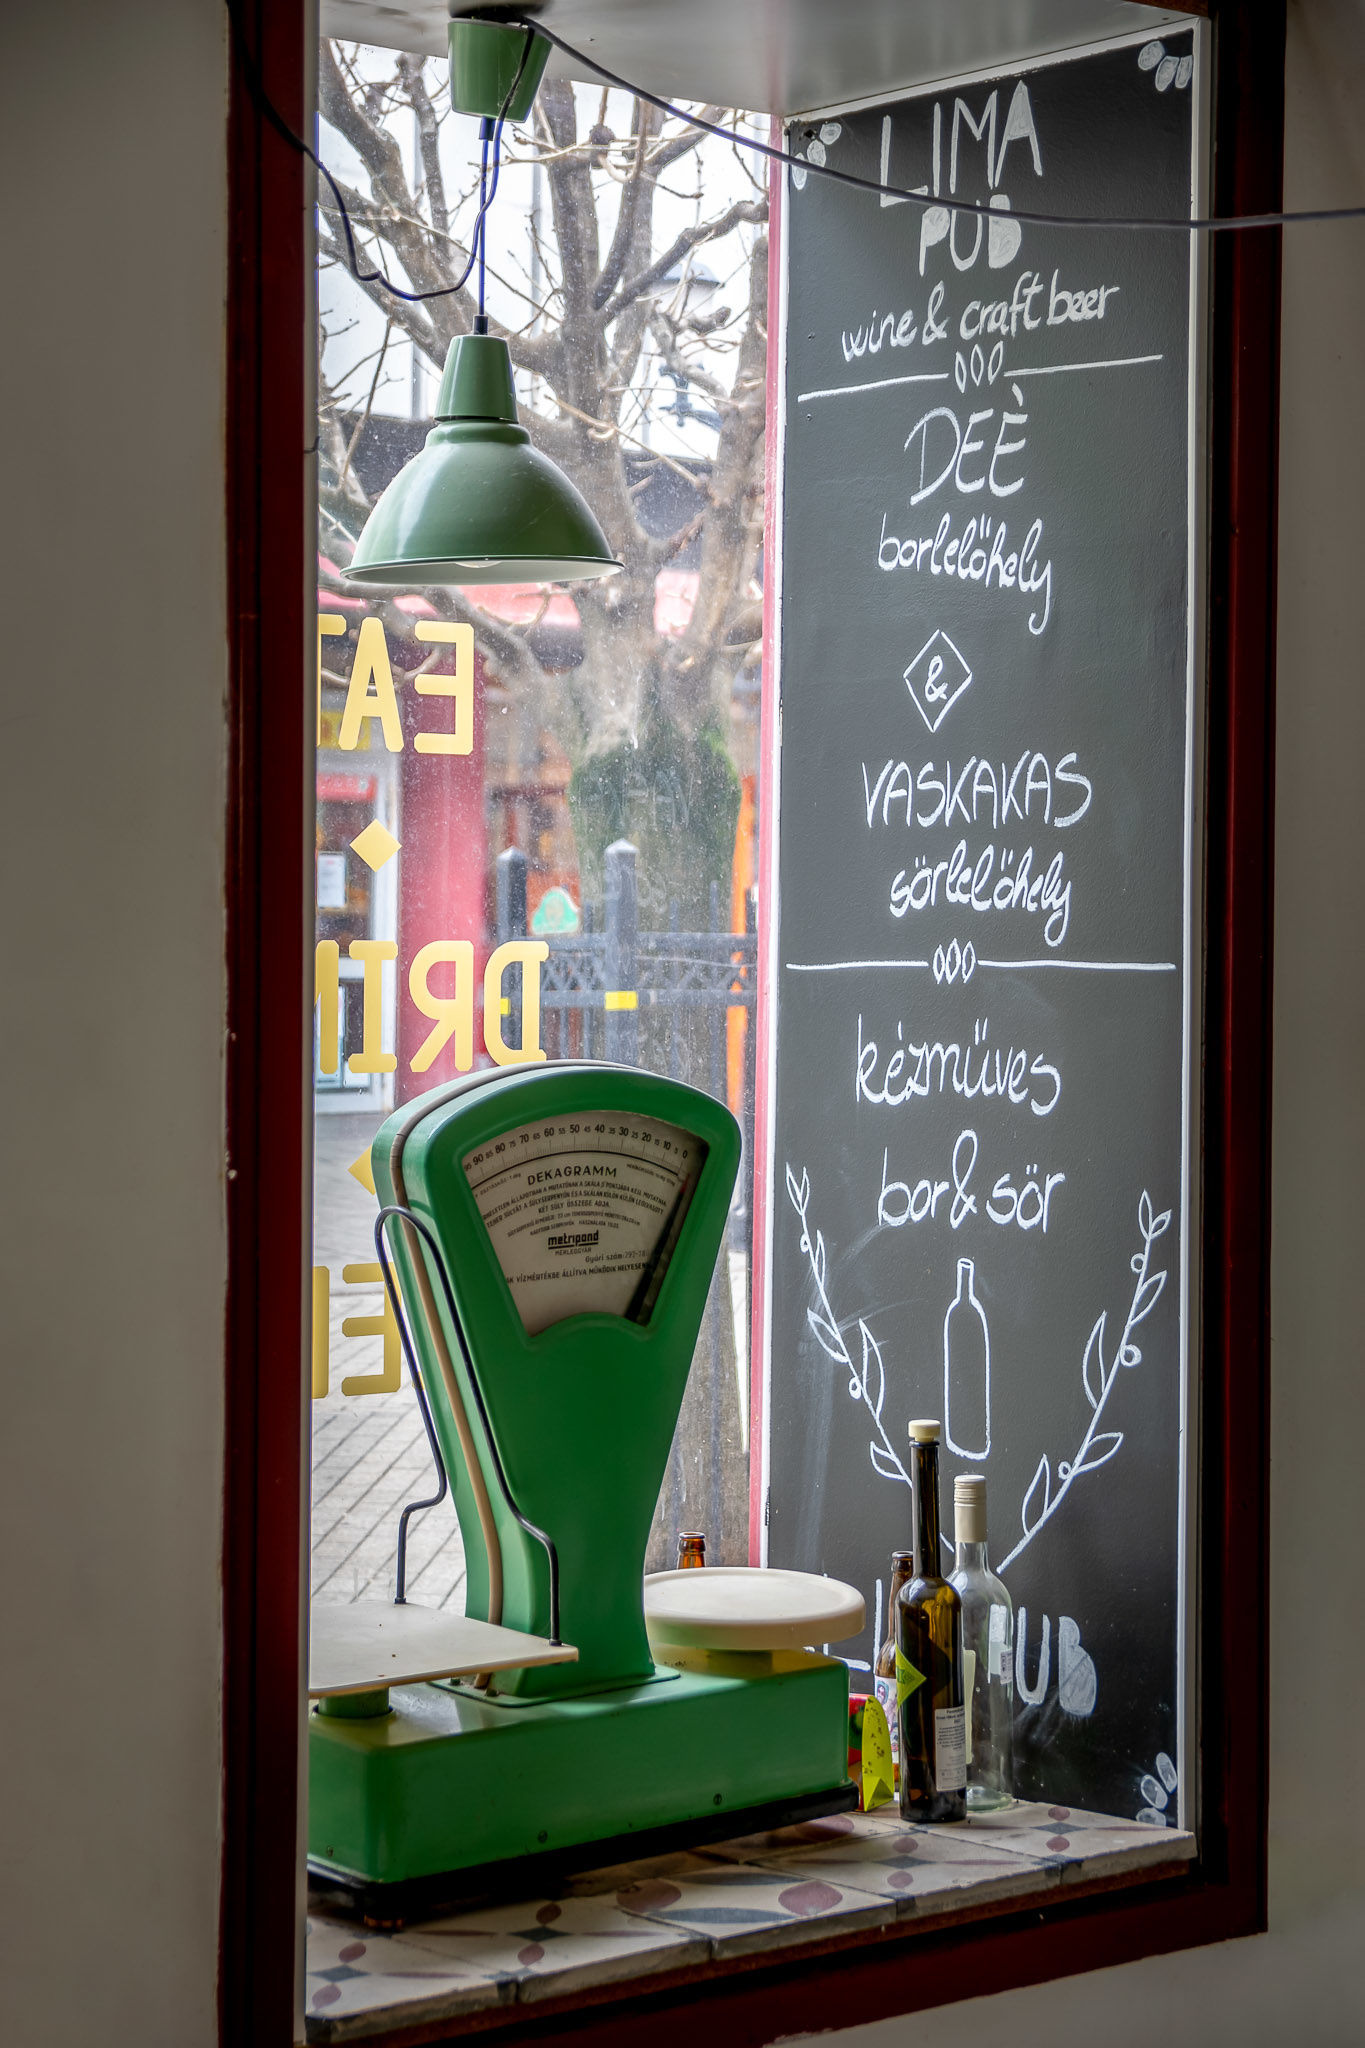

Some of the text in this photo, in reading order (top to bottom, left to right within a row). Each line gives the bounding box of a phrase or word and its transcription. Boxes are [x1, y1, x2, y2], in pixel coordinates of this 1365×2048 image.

[880, 80, 1043, 206] LIMA
[919, 194, 1022, 276] PUB
[841, 268, 1120, 362] wine & craft beer
[925, 654, 948, 702] &
[862, 750, 1092, 828] VASKAKAS
[473, 1154, 483, 1165] 90
[495, 1142, 506, 1153] 80
[519, 1134, 530, 1144] 70
[544, 1127, 555, 1137] 60
[570, 1124, 580, 1134] 50
[594, 1124, 605, 1134] 40
[618, 1126, 629, 1136] 30
[641, 1132, 652, 1142] 20
[664, 1140, 671, 1150] 10
[682, 1149, 688, 1159] 0
[527, 1165, 617, 1186] DEKAGRAMM
[547, 1229, 599, 1248] metripond
[562, 1268, 587, 1279] ÁLLÍTVA
